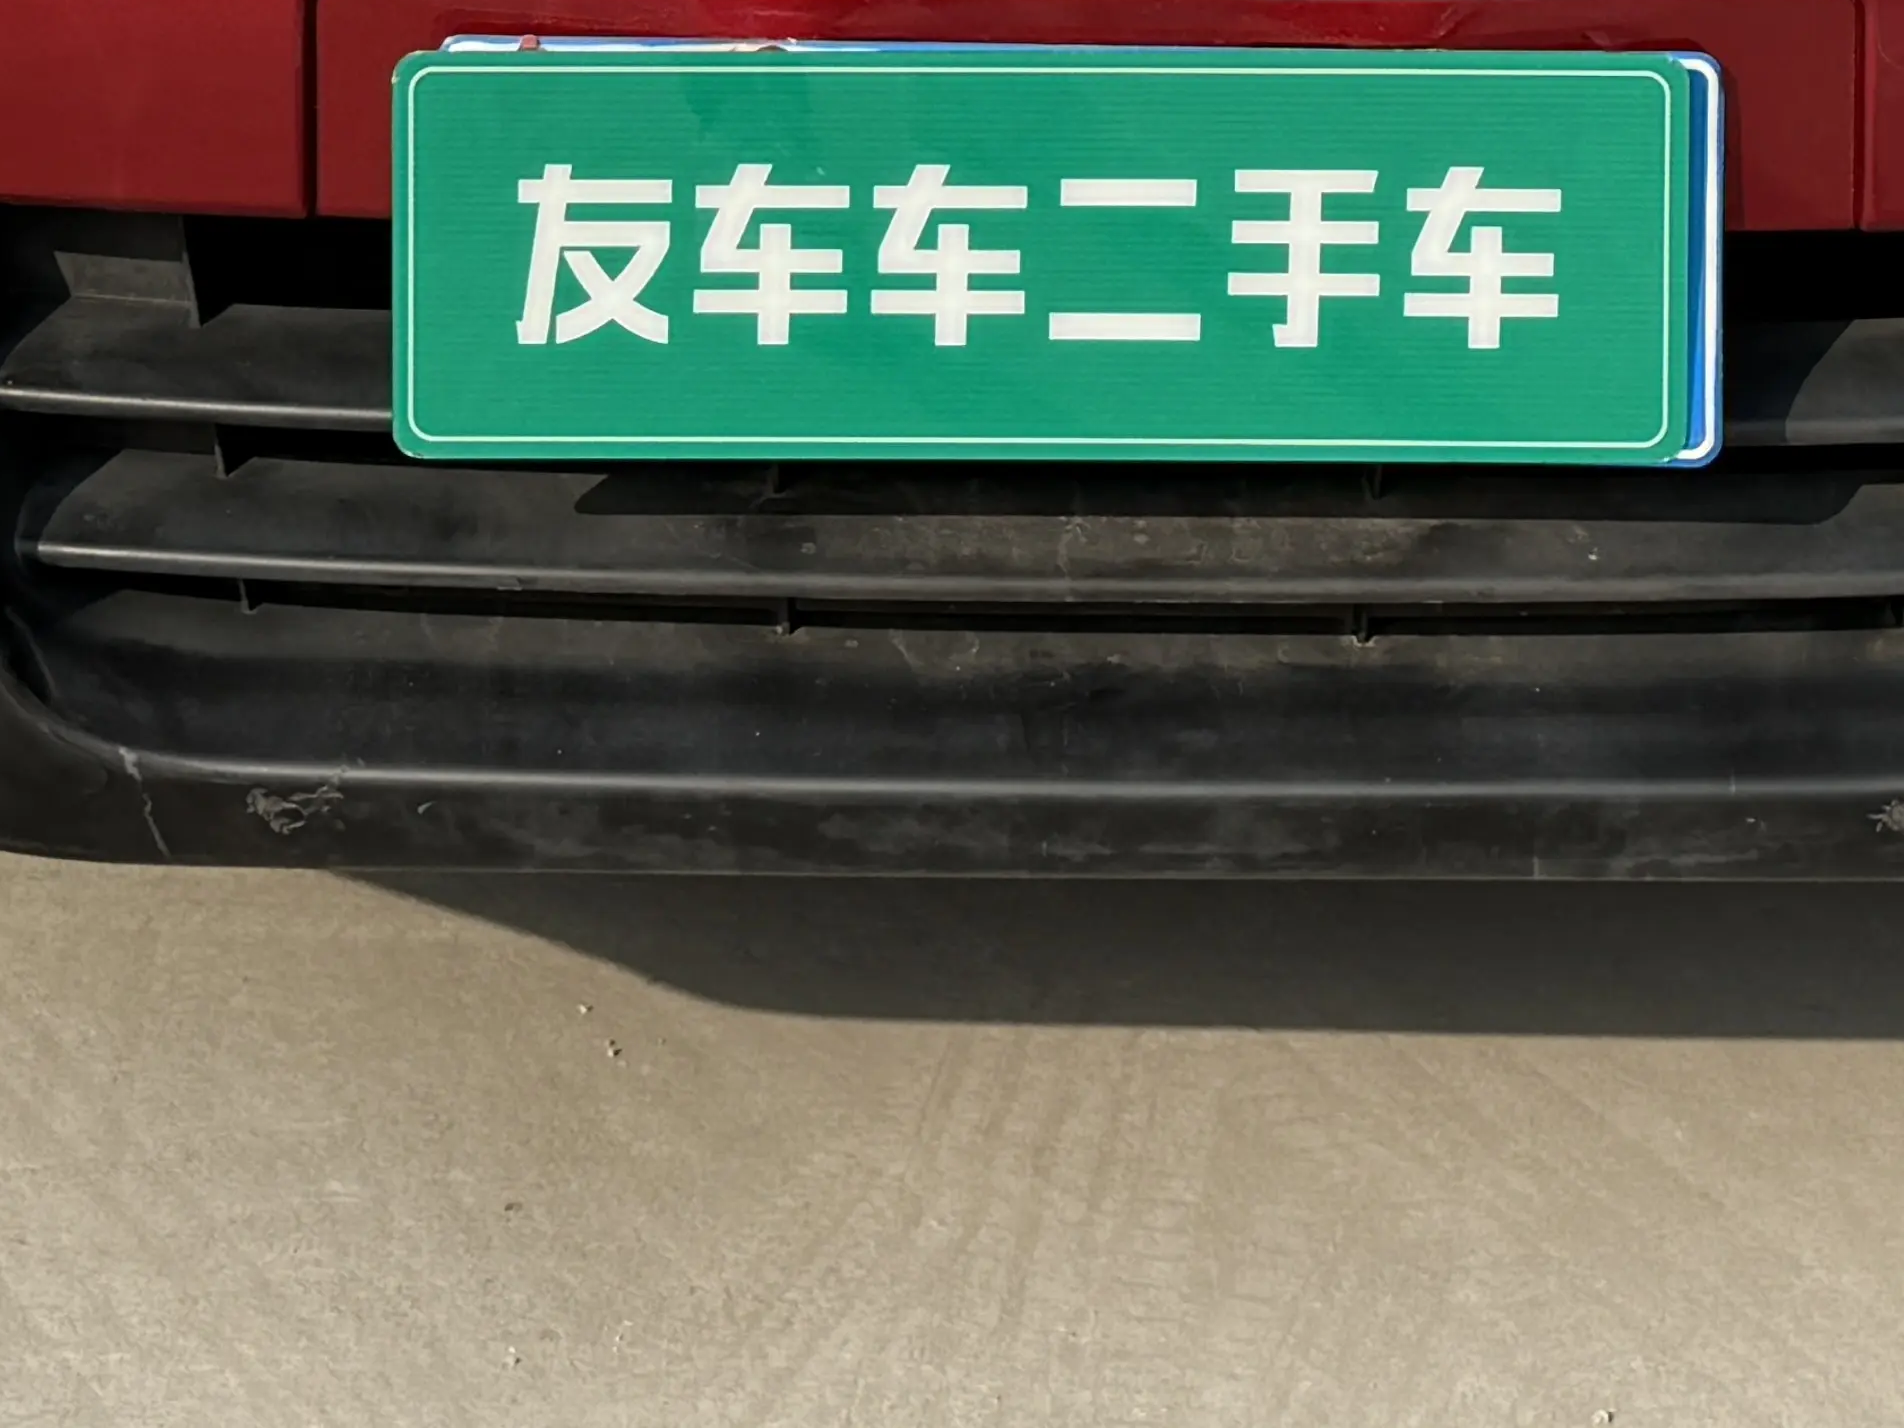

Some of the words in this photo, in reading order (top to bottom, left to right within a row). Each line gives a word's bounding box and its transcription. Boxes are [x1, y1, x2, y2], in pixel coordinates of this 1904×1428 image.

[516, 163, 1562, 350] 友车车二手车
